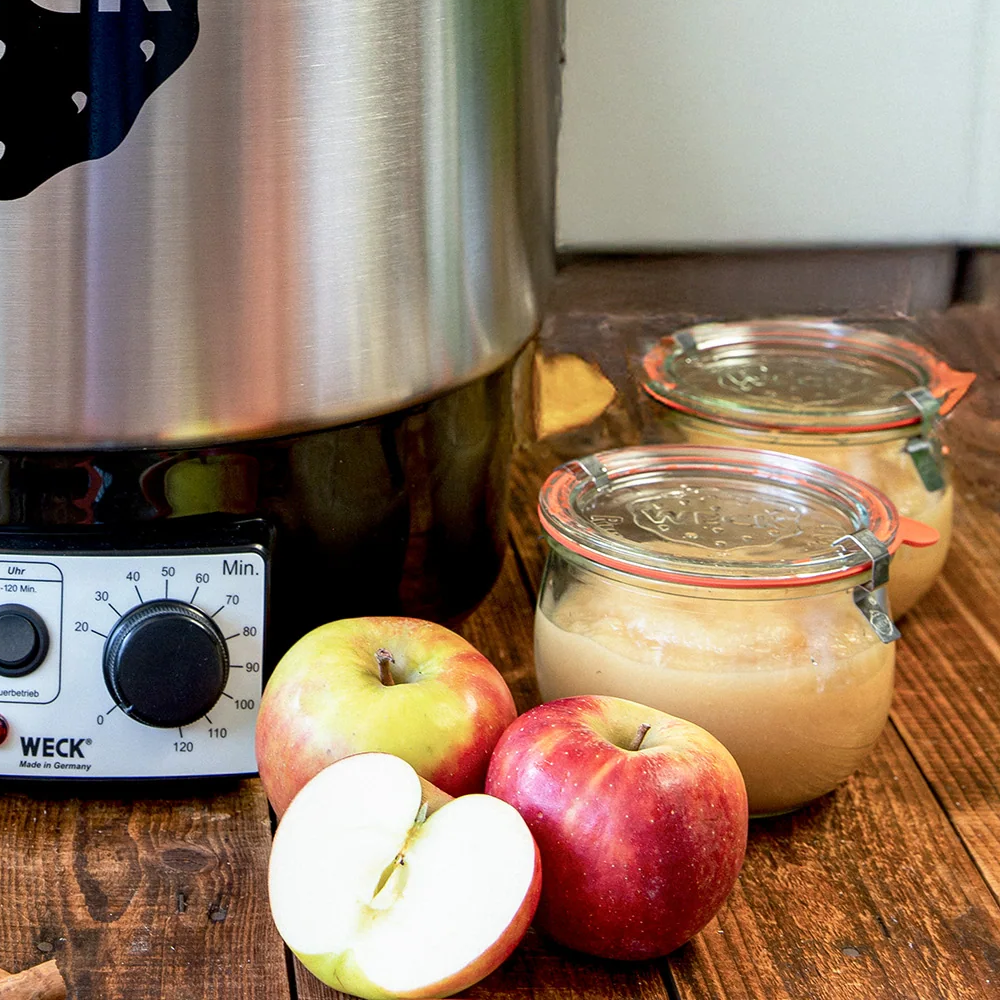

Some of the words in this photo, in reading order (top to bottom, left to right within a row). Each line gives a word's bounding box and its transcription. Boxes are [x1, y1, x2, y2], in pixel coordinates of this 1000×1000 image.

[7, 566, 26, 576] Uhr
[161, 566, 176, 577] 50
[222, 559, 259, 576] Min.
[125, 571, 141, 582] 40
[195, 572, 210, 584] 60
[94, 590, 109, 602] 30
[226, 594, 240, 606] 70
[74, 621, 89, 633] 20
[242, 626, 257, 637] 80
[245, 661, 260, 673] 90
[234, 699, 255, 710] 100
[96, 715, 105, 726] 0
[208, 727, 228, 739] 110
[173, 741, 194, 753] 120
[19, 760, 42, 769] Made
[43, 761, 52, 769] in
[53, 761, 92, 773] Germany
